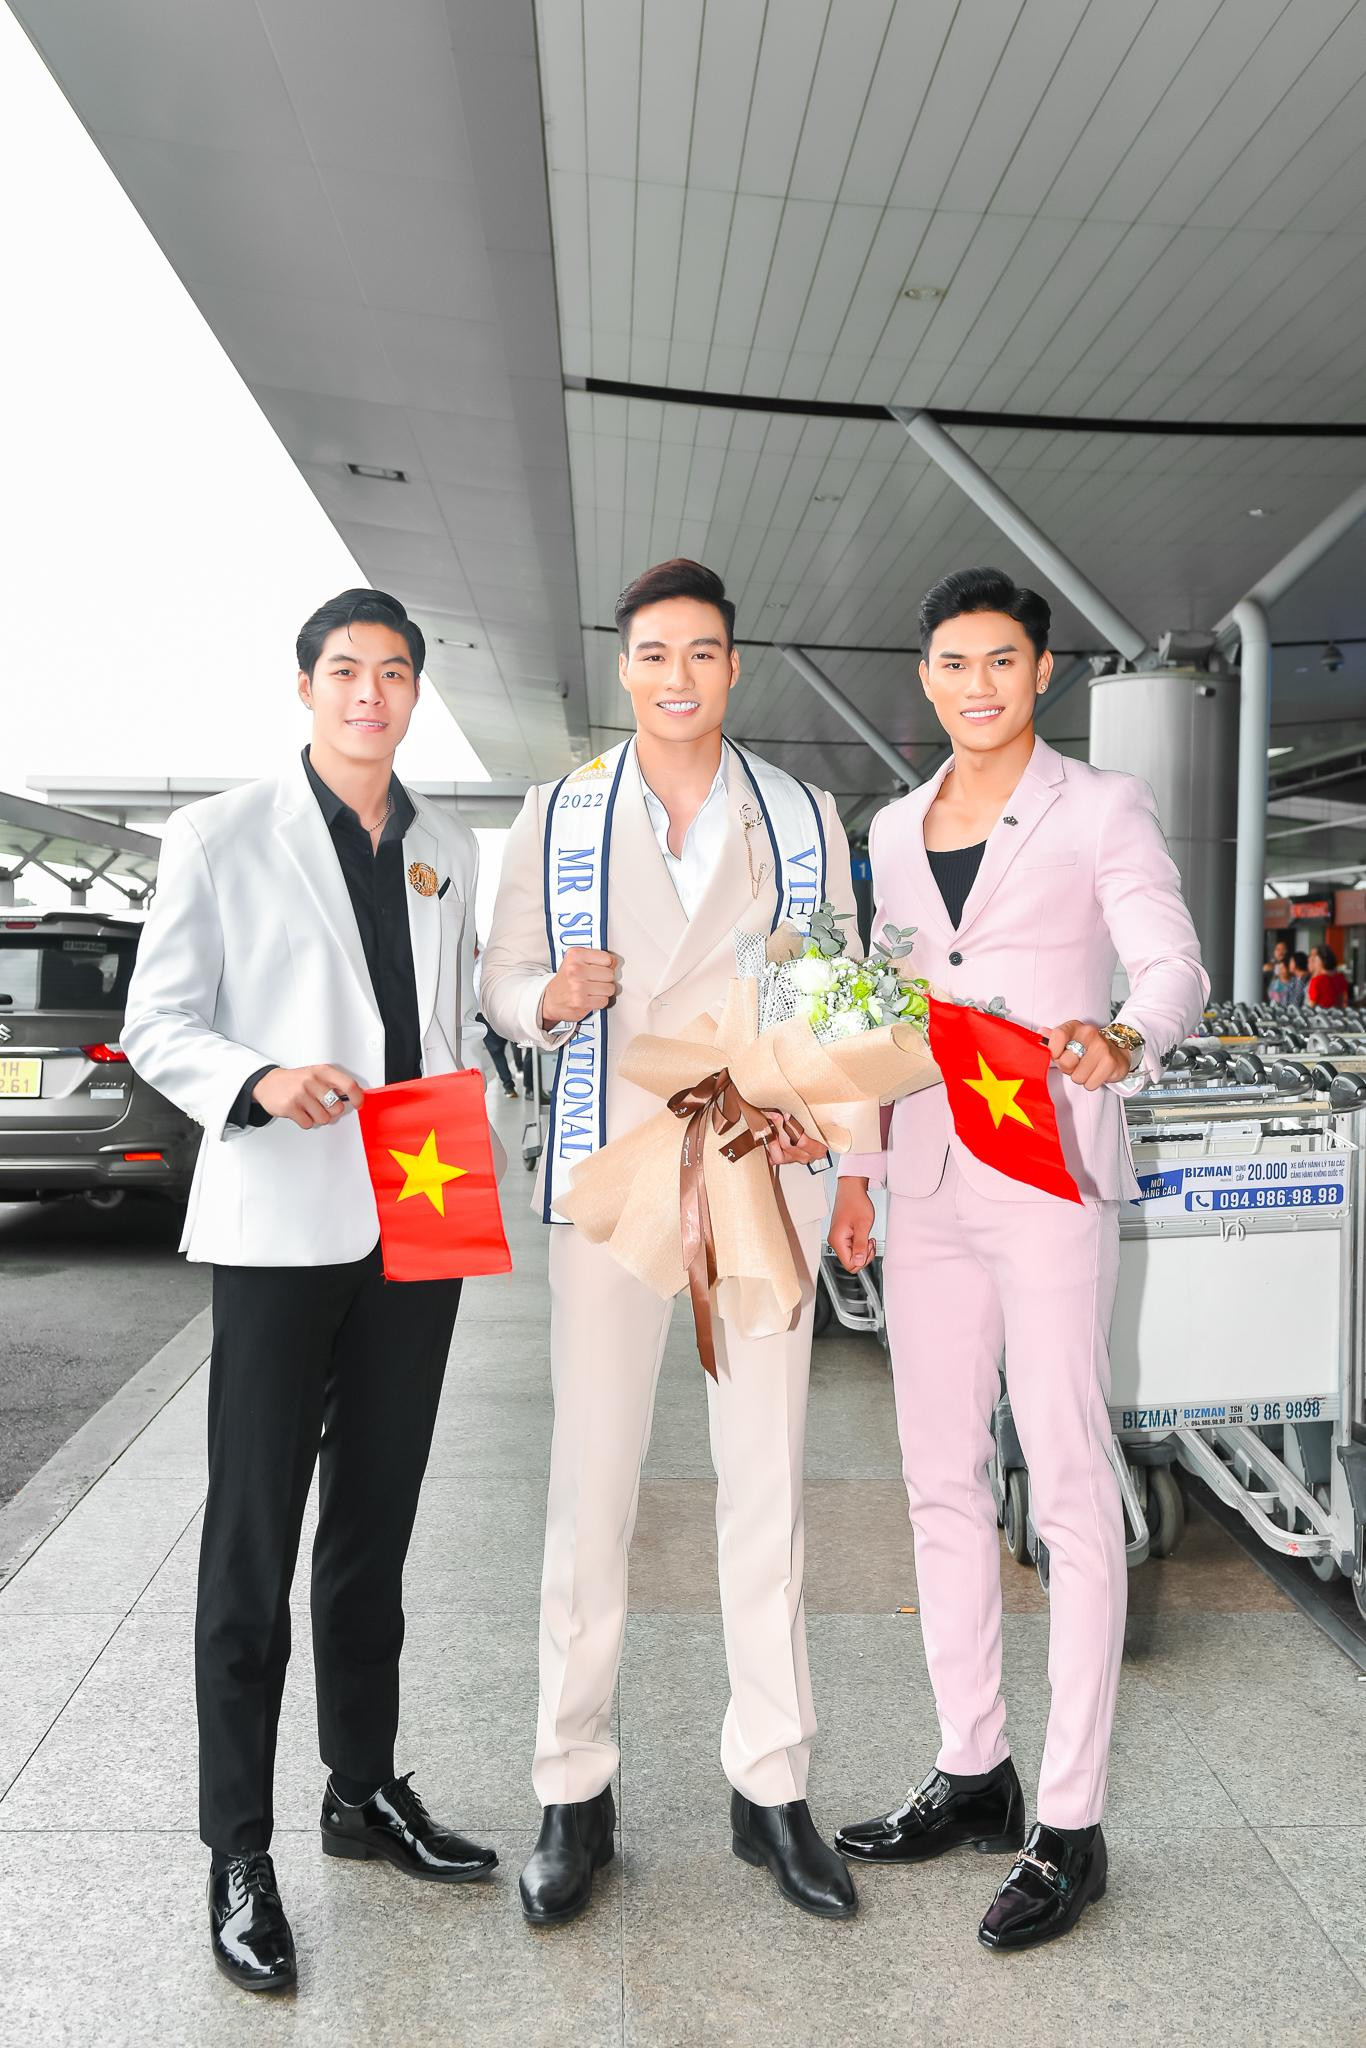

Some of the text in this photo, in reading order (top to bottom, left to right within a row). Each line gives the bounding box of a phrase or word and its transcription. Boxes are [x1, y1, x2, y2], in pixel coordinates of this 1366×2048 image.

[560, 793, 604, 808] 2022
[558, 846, 595, 895] MR
[1185, 1166, 1231, 1178] BIZMAN
[1248, 1162, 1287, 1180] 20.000
[1220, 1187, 1337, 1208] 094.986.98.98
[1184, 1407, 1225, 1418] BIZMAN
[1286, 1400, 1320, 1419] 9898
